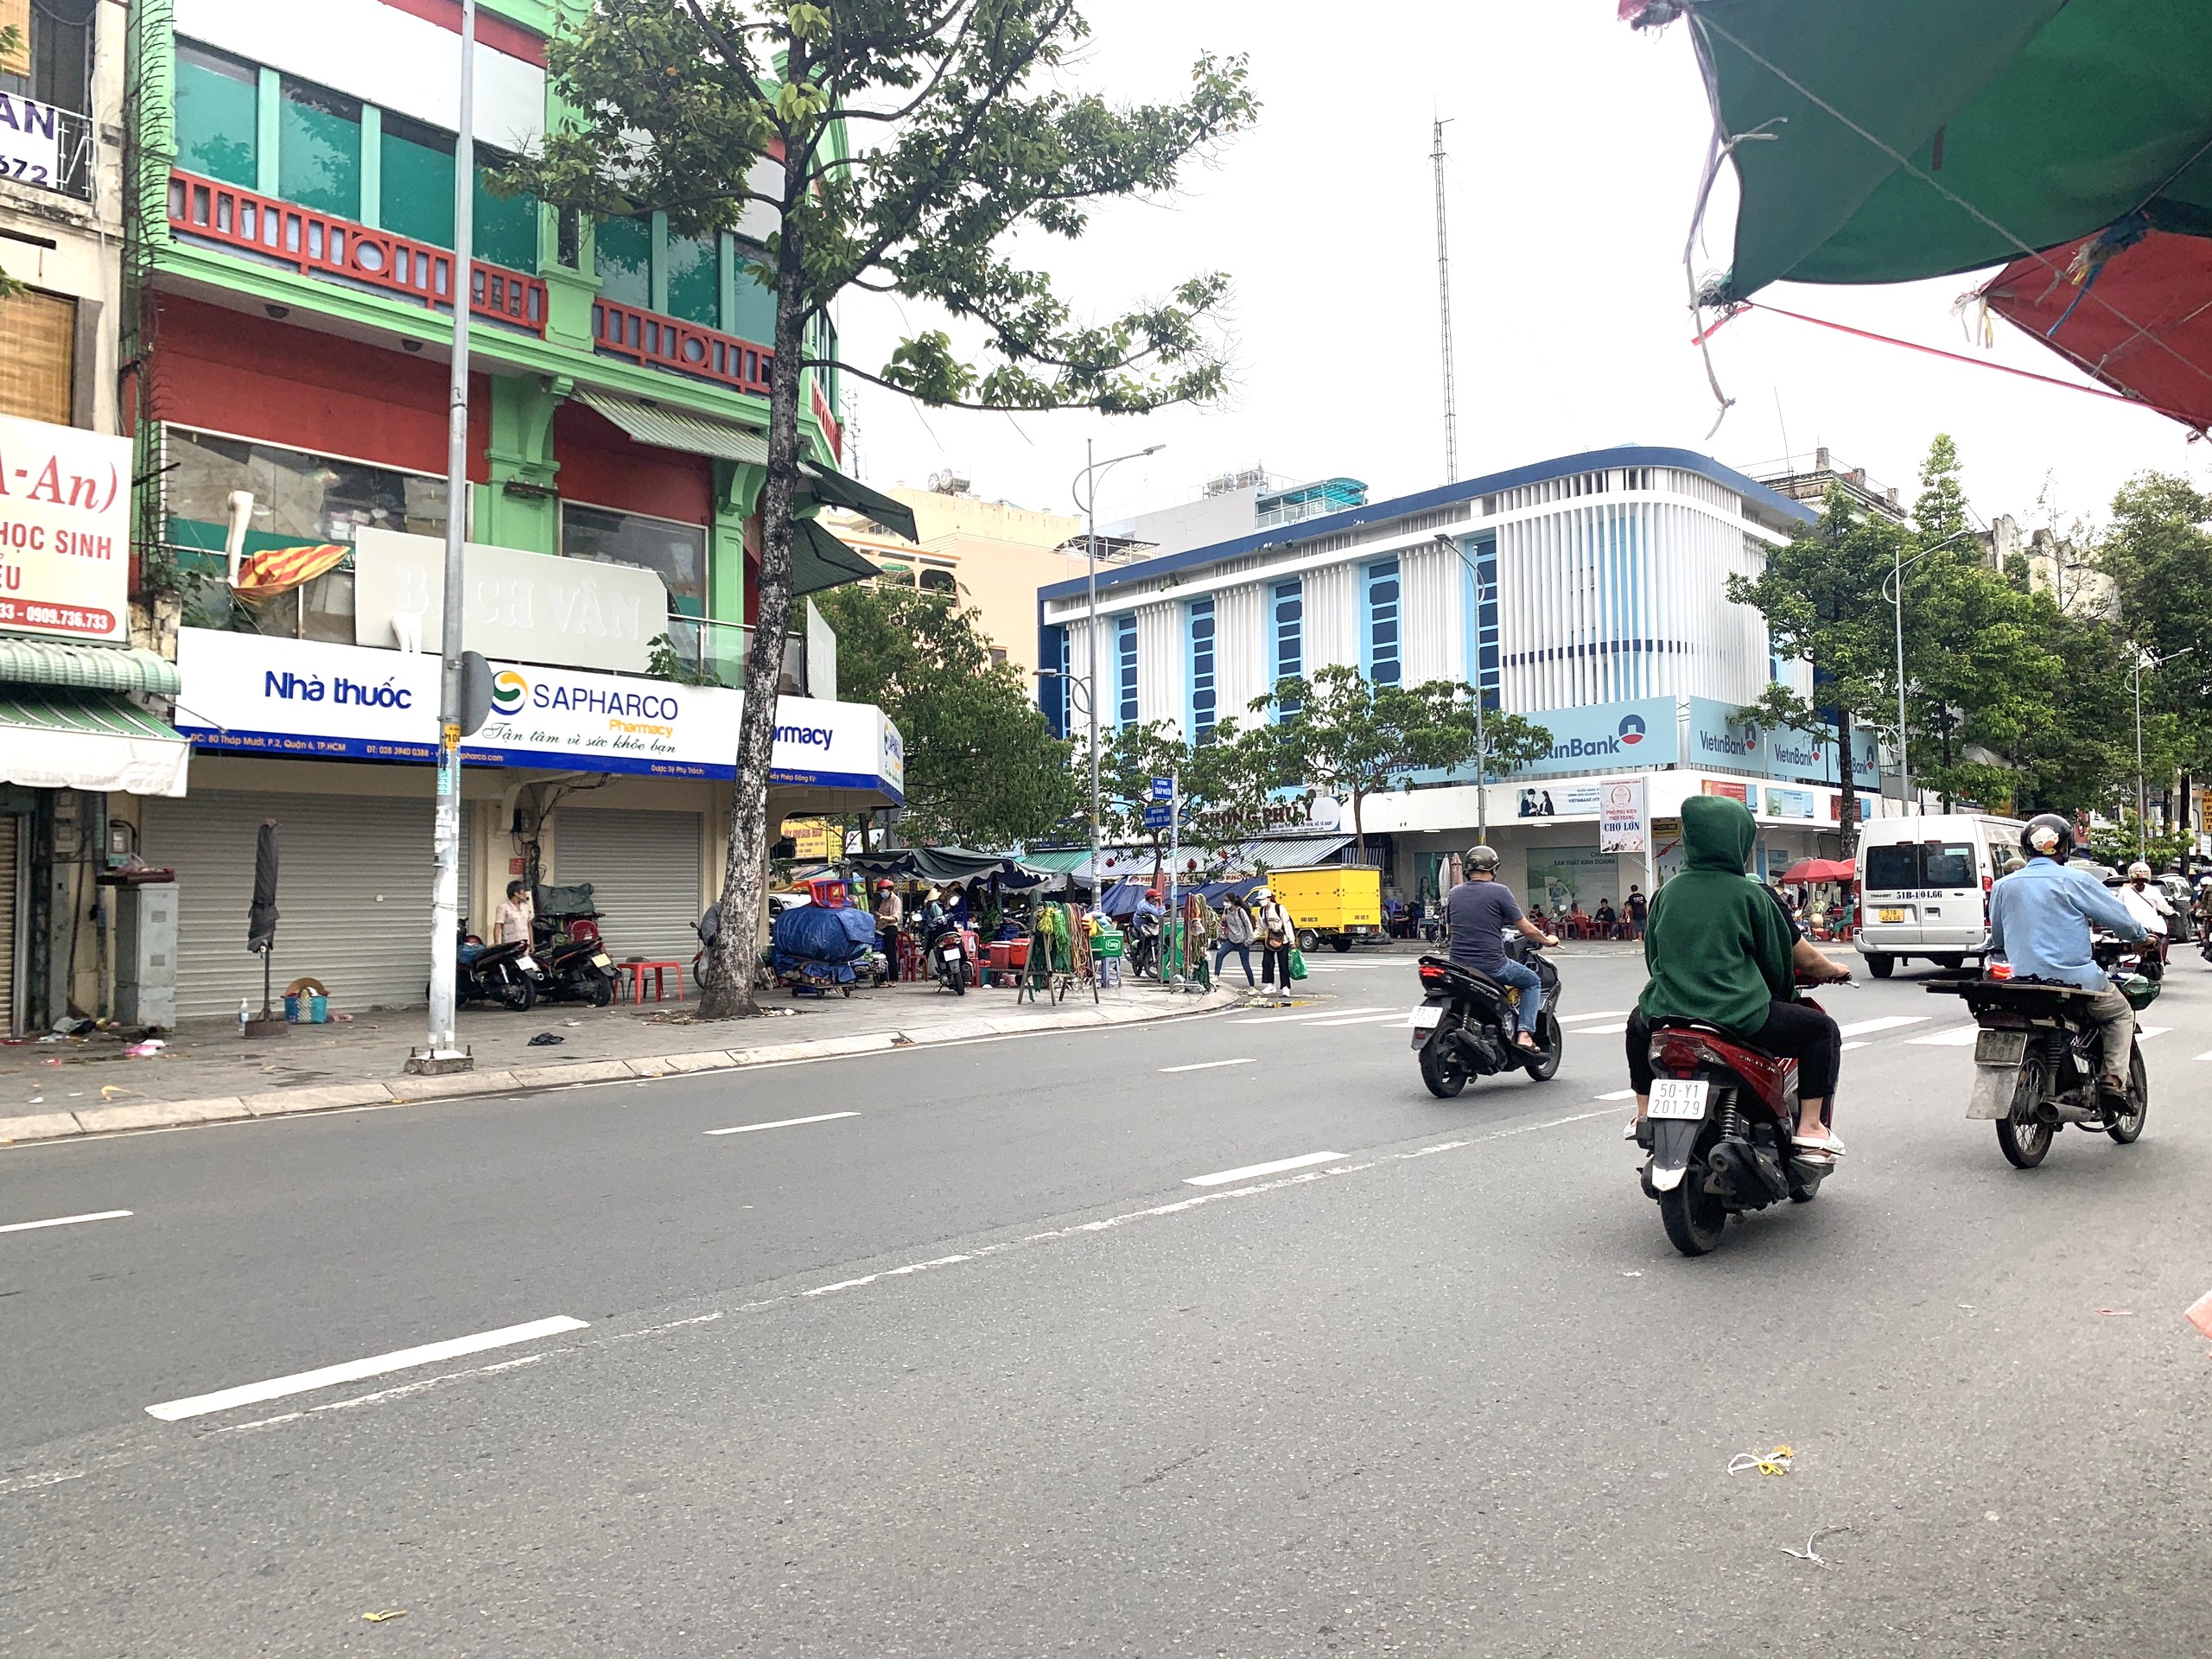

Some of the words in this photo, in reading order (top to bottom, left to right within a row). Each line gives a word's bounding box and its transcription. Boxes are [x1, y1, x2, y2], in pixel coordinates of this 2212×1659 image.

[0, 450, 118, 513] -An)
[54, 529, 111, 561] SINH
[397, 563, 534, 628] BCH
[26, 605, 108, 631] 0909.736.733
[264, 670, 325, 702] Nhà
[334, 676, 412, 710] thuốc
[533, 683, 678, 721] SAPHARCO
[481, 721, 524, 743] Tận
[530, 730, 560, 744] tâm
[567, 734, 582, 745] vì
[586, 735, 608, 747] sức
[613, 734, 645, 751] khỏe
[651, 738, 677, 754] bạn
[609, 718, 673, 739] Pharmacy
[772, 725, 834, 751] armacy
[208, 734, 219, 744] 80
[220, 734, 241, 747] Tháp
[268, 739, 283, 748] P.2,
[284, 740, 307, 750] Quận
[317, 741, 346, 752] TP.HCM
[379, 746, 392, 754] 028
[394, 747, 410, 756] 3940
[1700, 729, 1746, 756] VietinBank
[1774, 743, 1813, 767] VietinBank
[1835, 753, 1868, 775] VBank
[1604, 822, 1621, 833] CHỢ
[1624, 820, 1640, 831] LỚN
[1659, 1083, 1699, 1098] 50-Y1
[1652, 1099, 1700, 1116] 201.79
